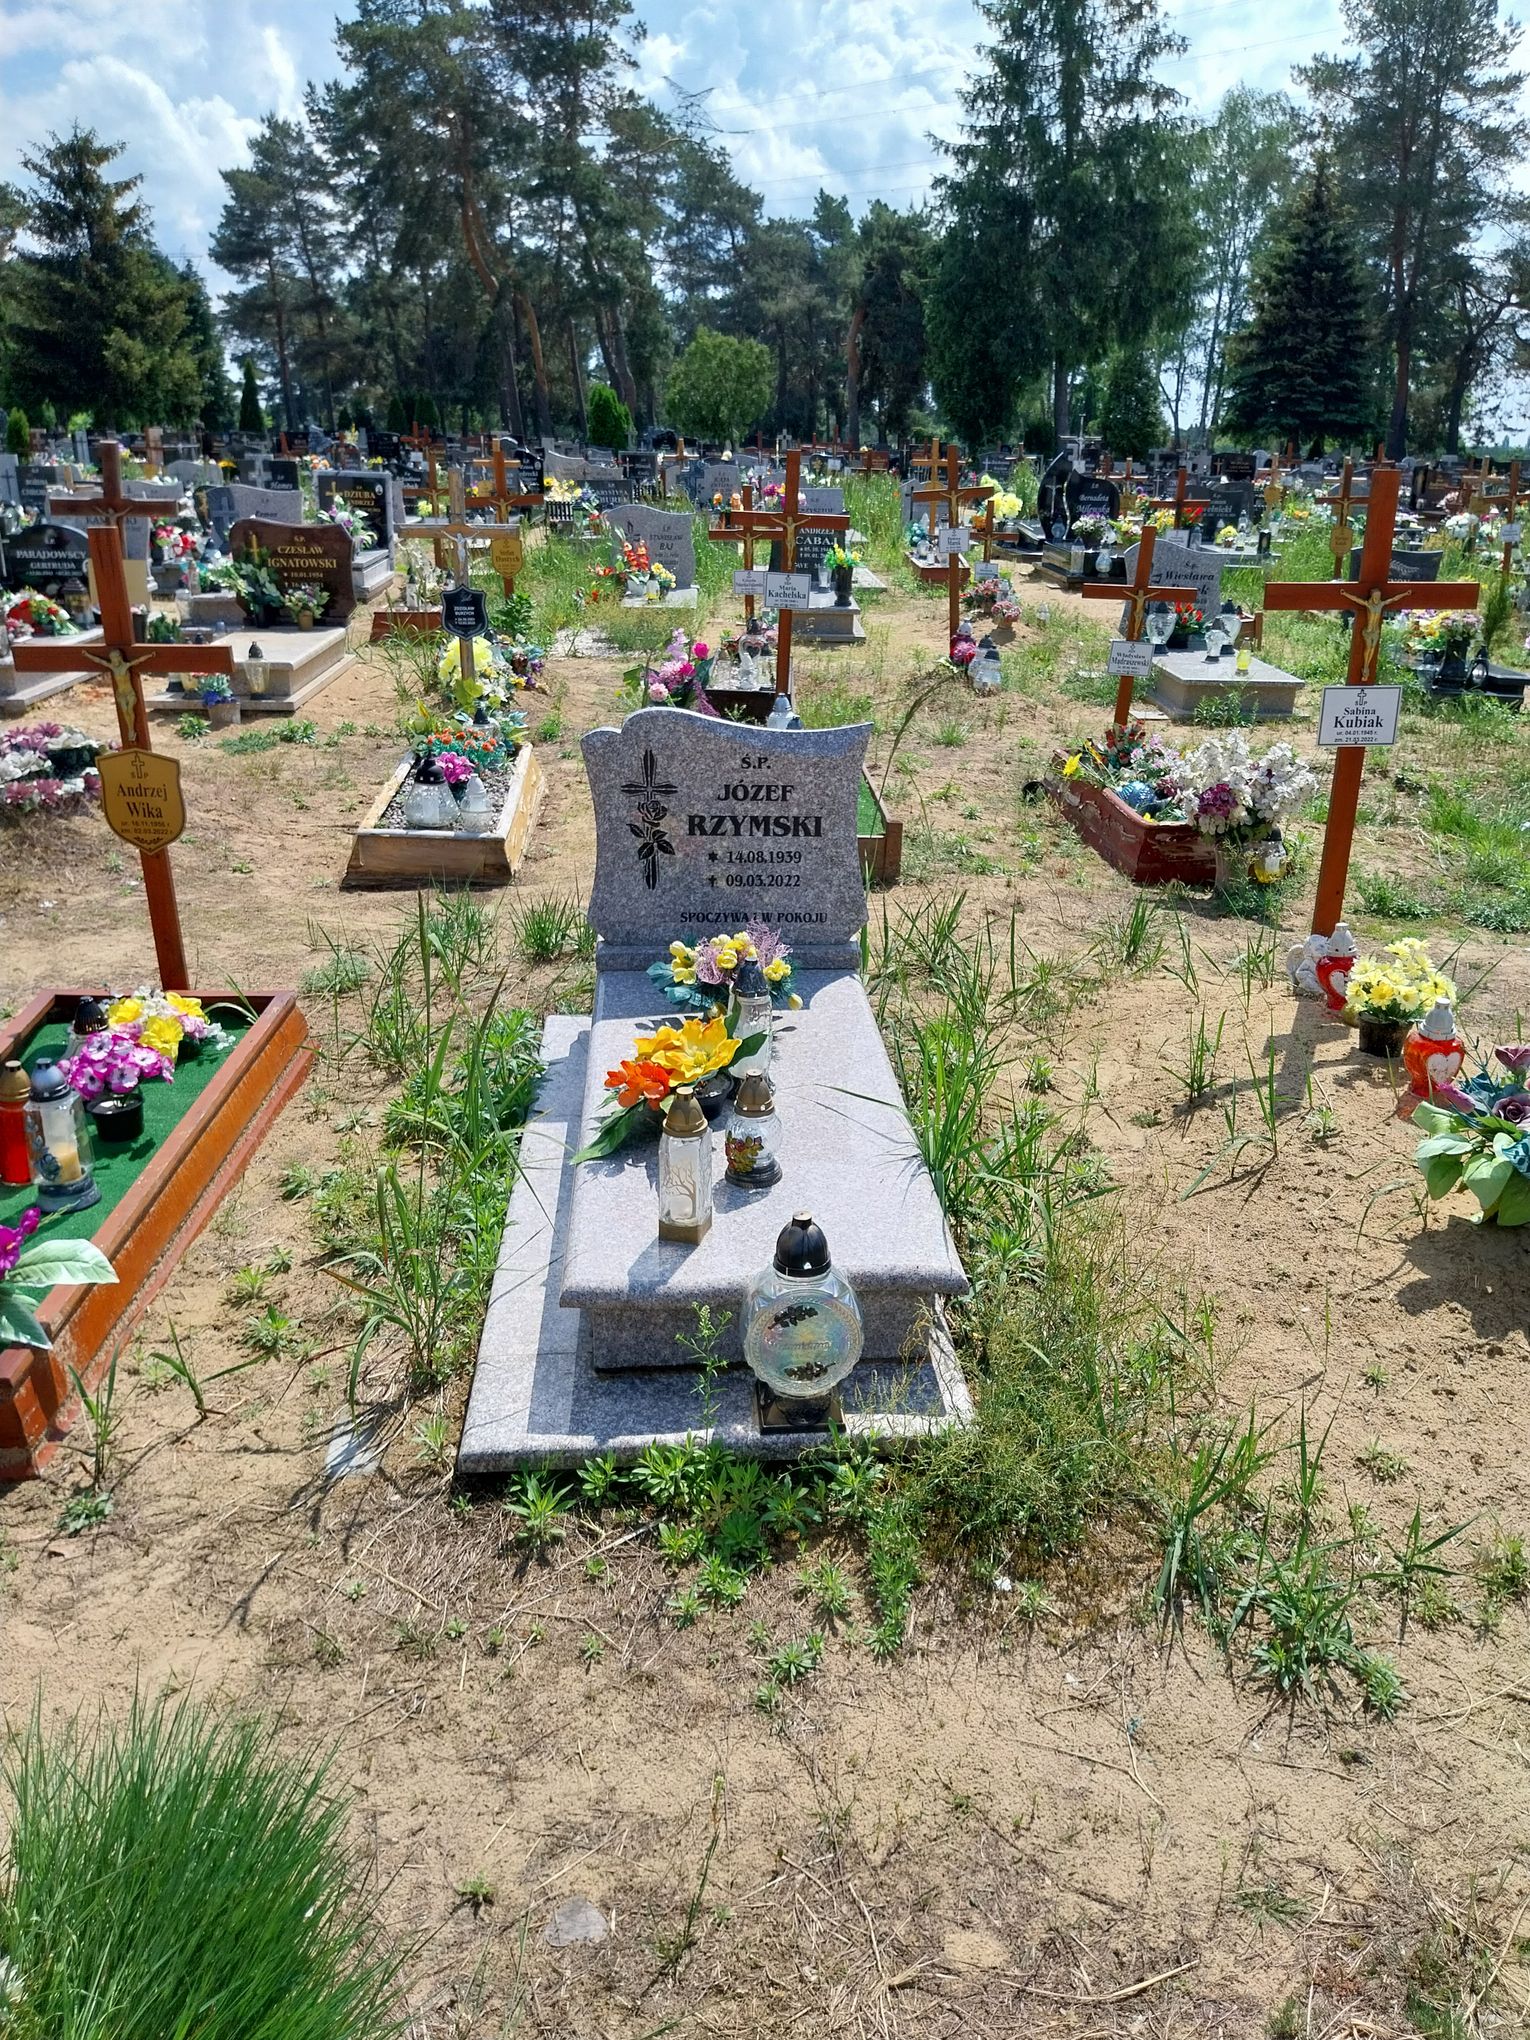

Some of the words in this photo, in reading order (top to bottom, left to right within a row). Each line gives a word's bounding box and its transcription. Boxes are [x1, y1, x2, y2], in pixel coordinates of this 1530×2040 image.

[799, 527, 835, 535] ANDRZEJ
[795, 536, 837, 546] CABAJ
[267, 558, 337, 568] IGNATOWSKI
[768, 589, 806, 599] Kachelska
[1343, 706, 1376, 715] Sabina
[1333, 715, 1384, 728] Kubiak
[741, 754, 772, 770] Ś.P.
[117, 783, 168, 802] Andrzej
[717, 779, 795, 802] JÓZEF
[126, 801, 163, 819] Wika
[687, 814, 823, 838] RZYMSKI
[726, 850, 802, 864] 14.08.1939
[725, 873, 800, 888] 09.03.2022
[762, 912, 773, 922] W
[777, 912, 828, 923] POKOJU
